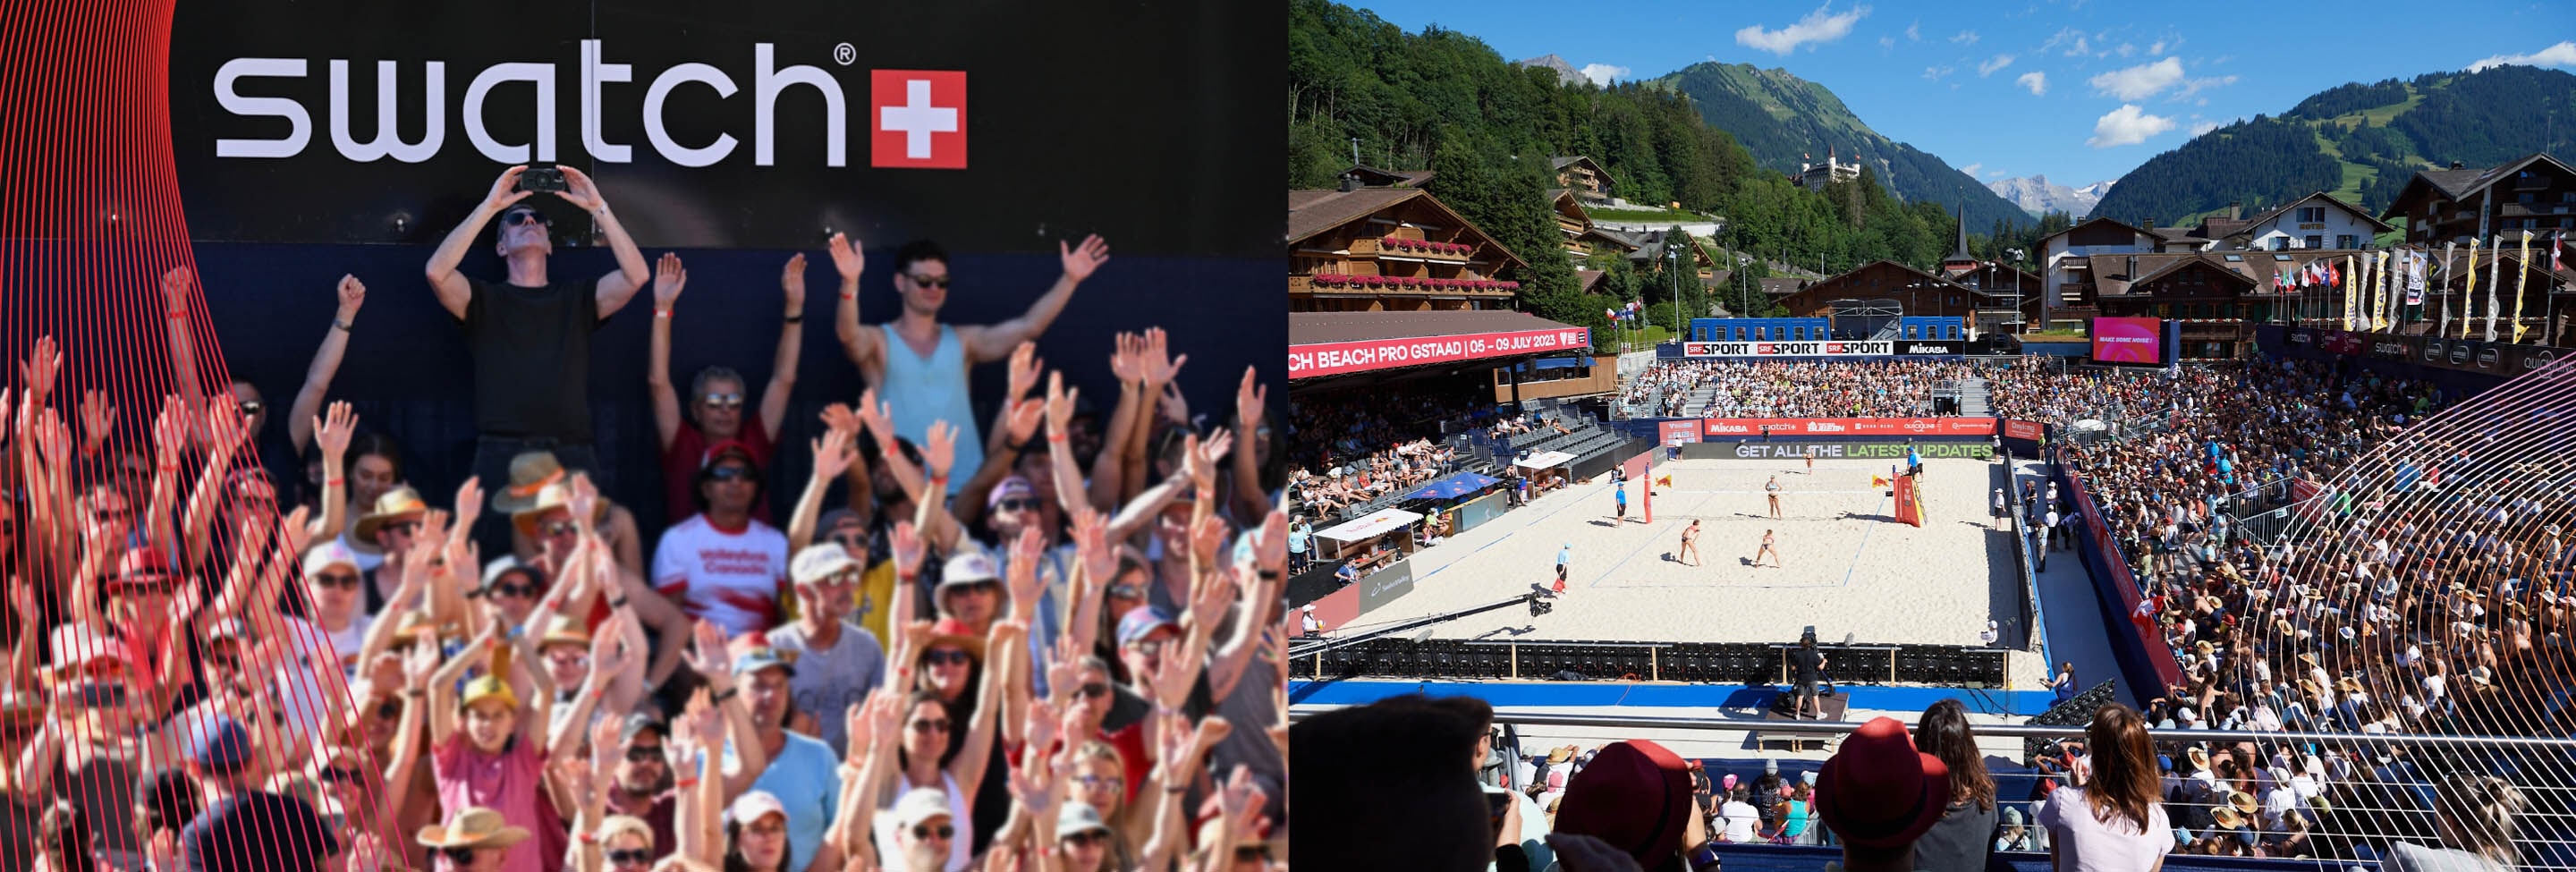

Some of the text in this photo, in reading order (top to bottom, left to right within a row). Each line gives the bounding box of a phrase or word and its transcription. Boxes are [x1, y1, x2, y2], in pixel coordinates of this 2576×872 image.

[1318, 348, 1376, 368] BEACH
[1378, 345, 1408, 362] PRO
[1411, 341, 1462, 359] GSTAAD
[1470, 340, 1486, 353] 05
[1496, 337, 1510, 351] 09
[1511, 336, 1532, 350] JULY
[1533, 334, 1556, 348] 2023
[1689, 343, 1750, 354] SRF SPORT
[1758, 343, 1819, 354] SRF SPORT
[1827, 343, 1889, 353] SRF SPORT
[2376, 343, 2402, 355] swatch
[1735, 444, 1993, 458] GET ALL THE LATEST UPDATES
